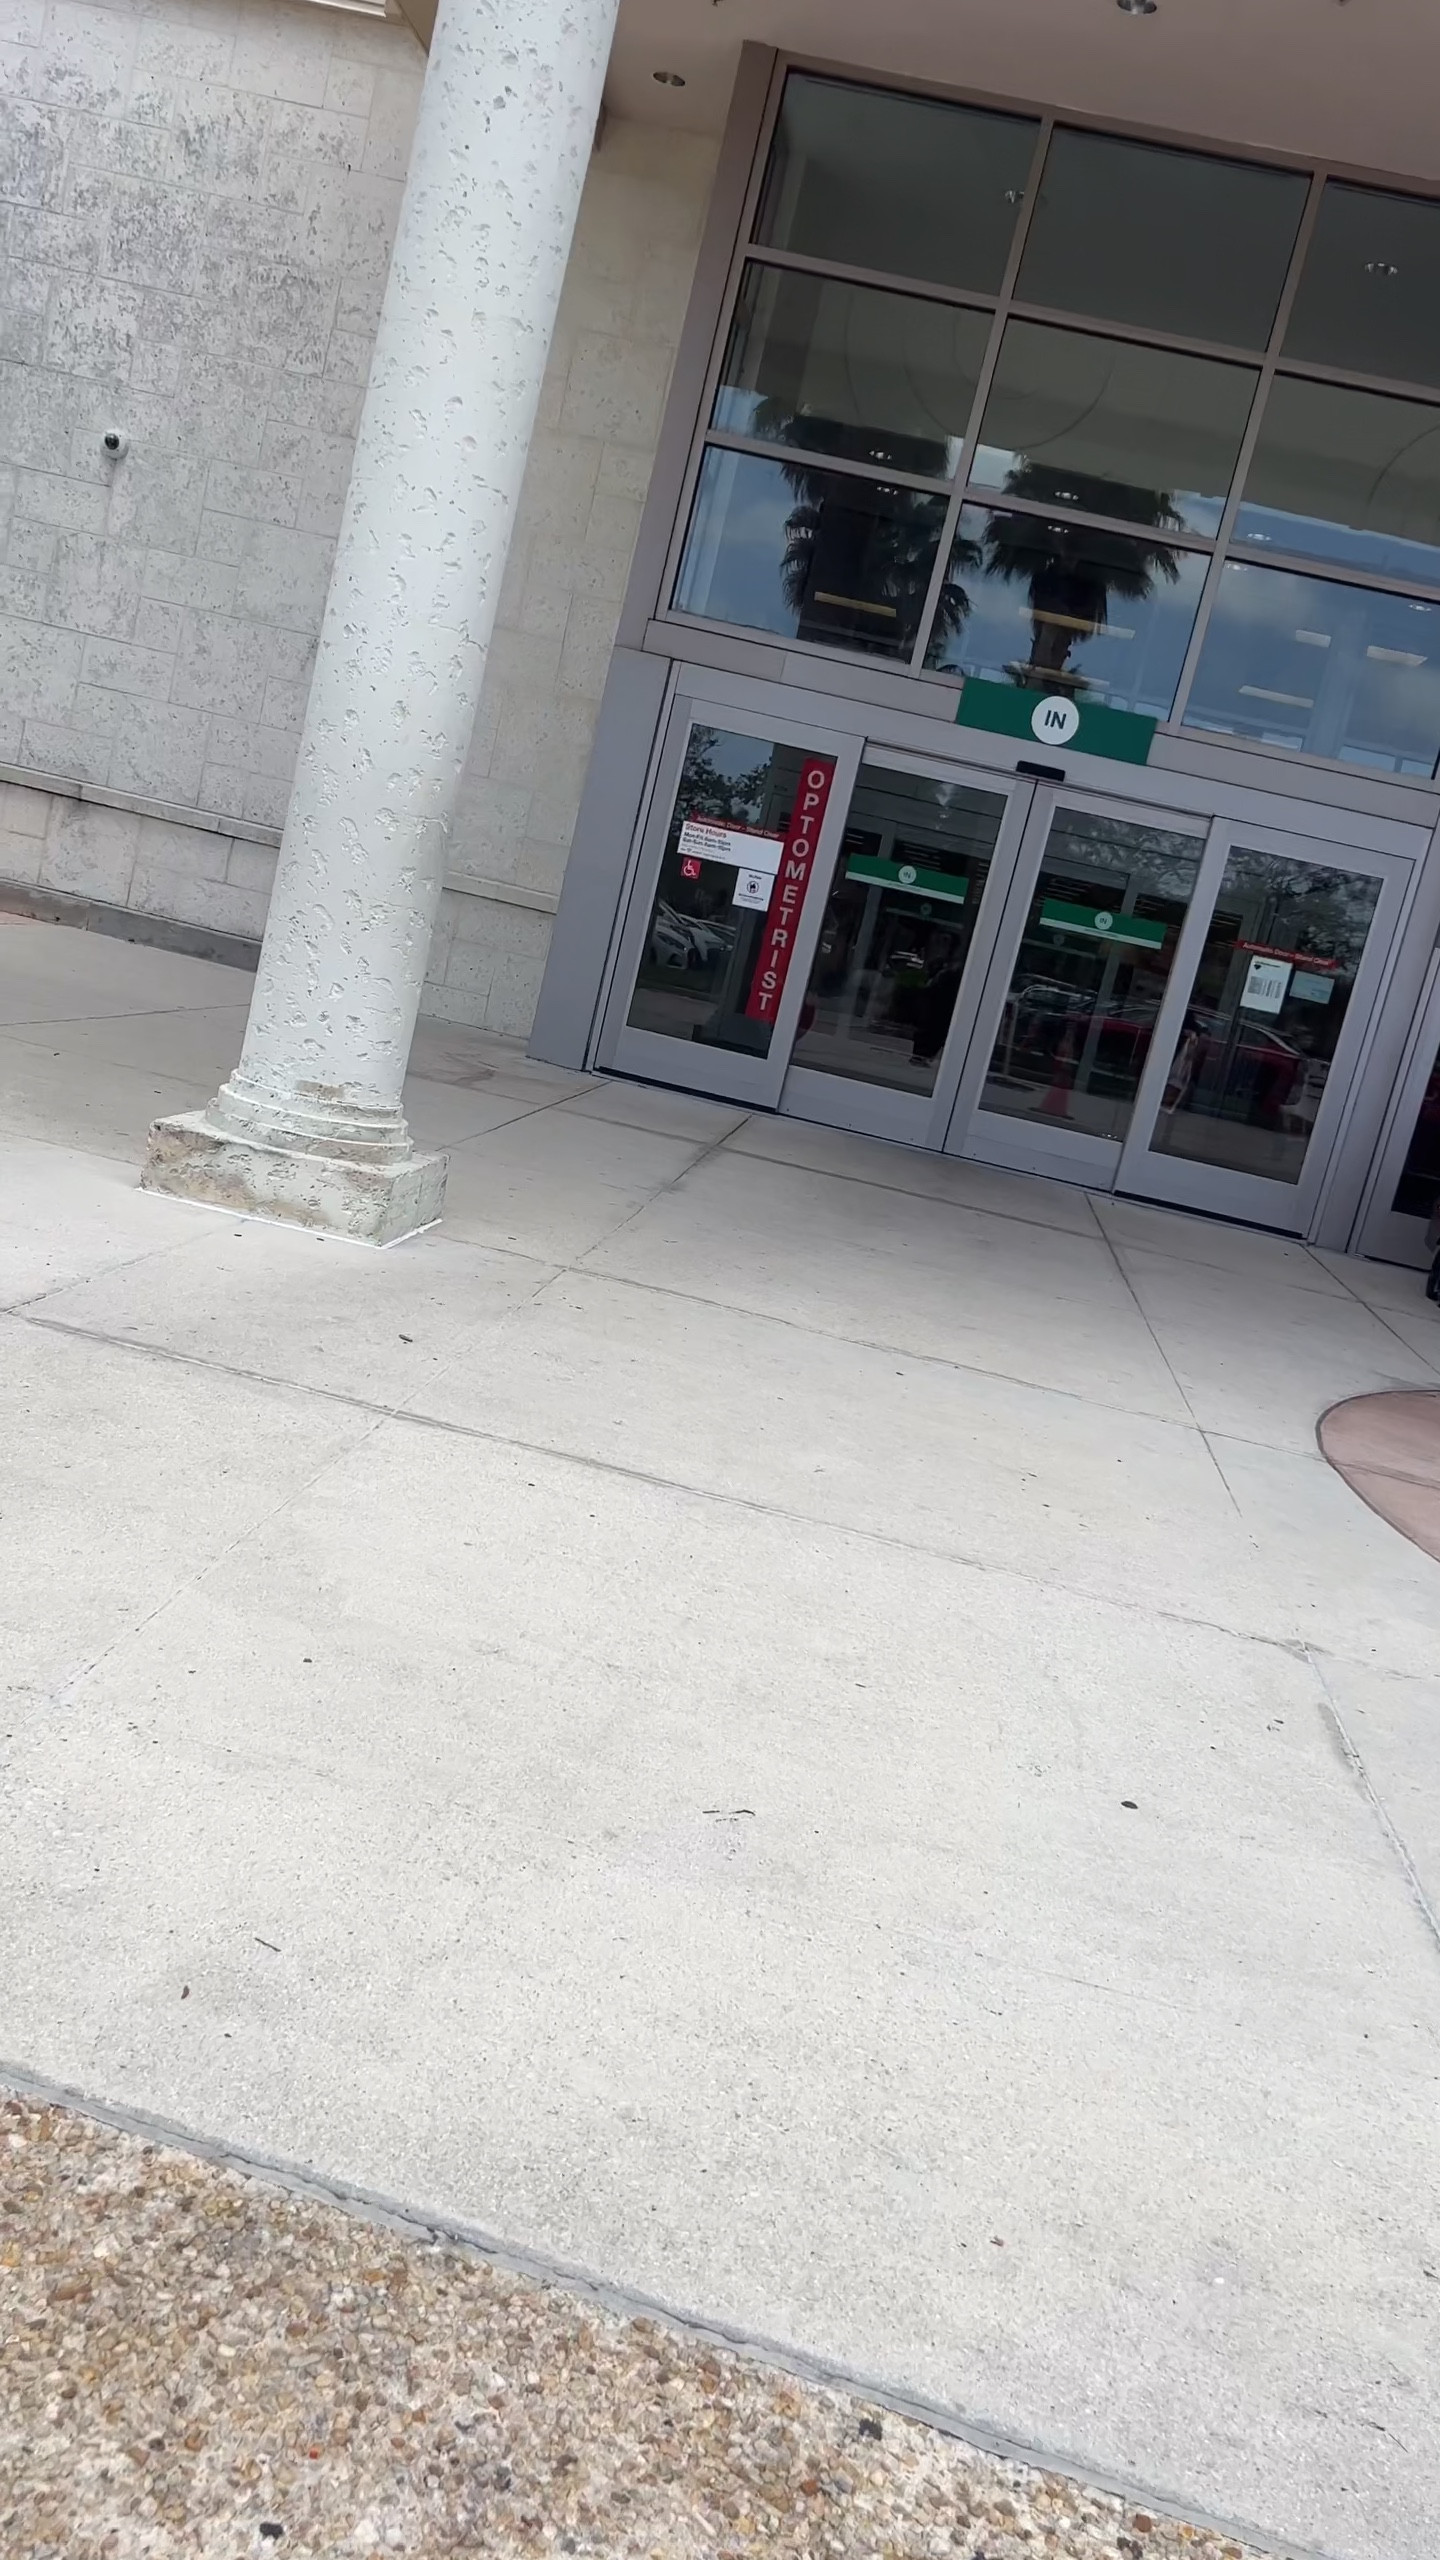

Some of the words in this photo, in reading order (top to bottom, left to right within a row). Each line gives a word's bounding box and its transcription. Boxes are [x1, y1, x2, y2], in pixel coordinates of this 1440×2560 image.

[1044, 709, 1067, 730] IN
[685, 823, 704, 835] Store
[705, 828, 727, 839] Hours
[758, 769, 825, 1011] OPTOMETRIST
